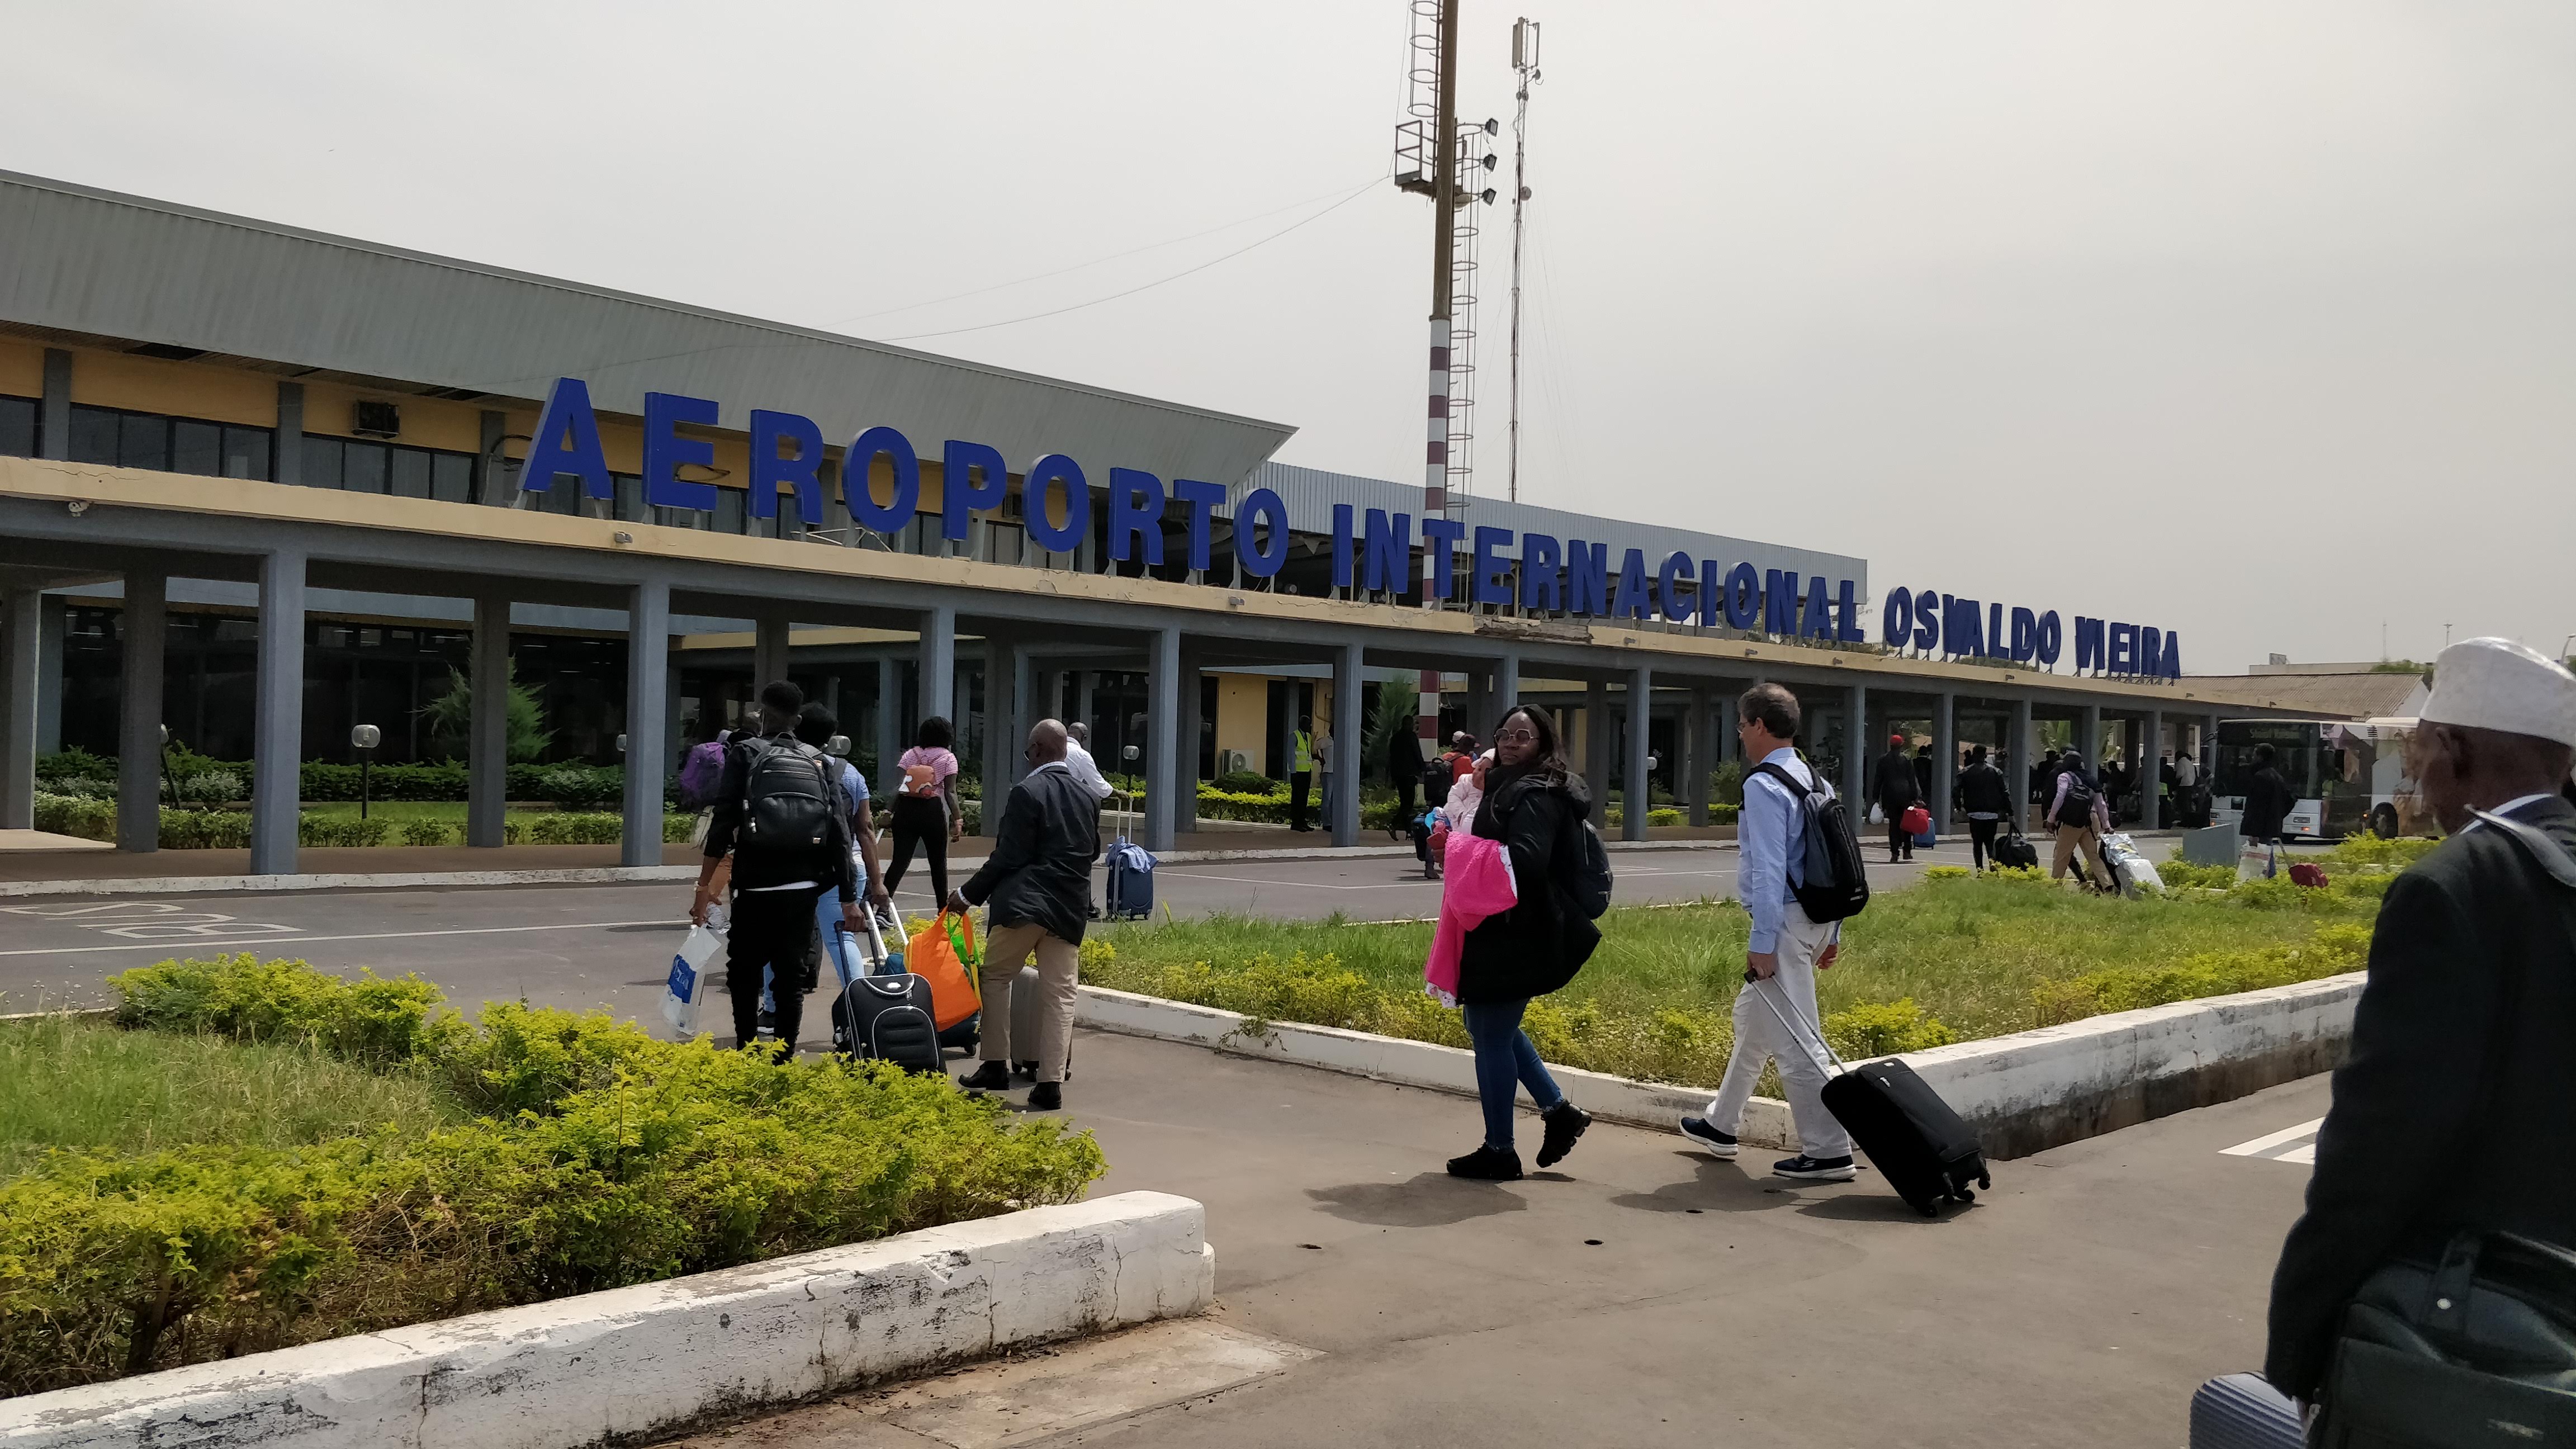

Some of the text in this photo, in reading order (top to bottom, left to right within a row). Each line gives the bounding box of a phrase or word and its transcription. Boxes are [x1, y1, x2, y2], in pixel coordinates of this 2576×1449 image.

[517, 377, 2180, 679] AEROPORTO INTERNACIONAL OSWALDO VIEIRA
